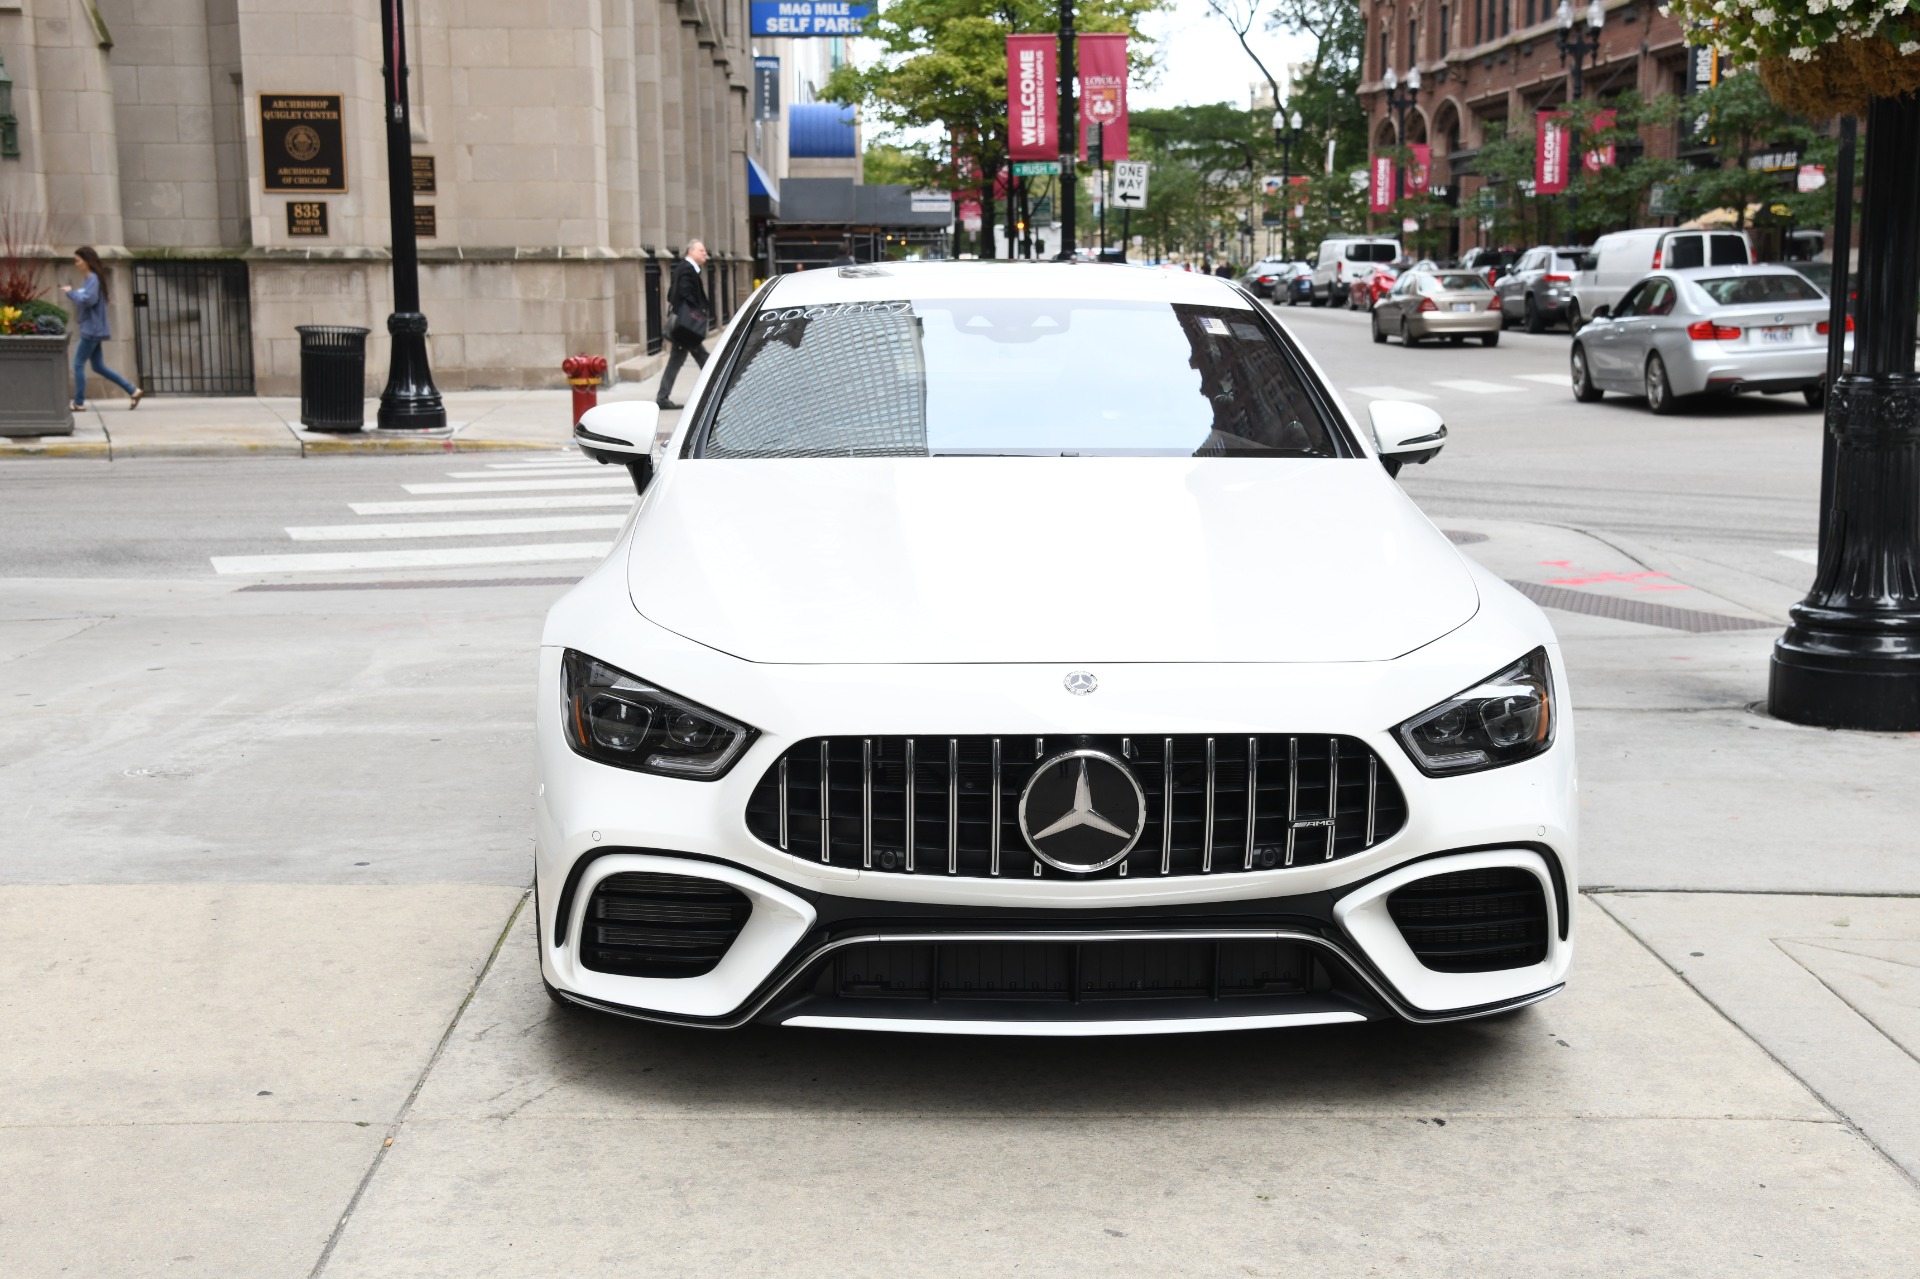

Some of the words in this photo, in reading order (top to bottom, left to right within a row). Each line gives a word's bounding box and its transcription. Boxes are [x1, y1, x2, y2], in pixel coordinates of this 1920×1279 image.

[779, 3, 812, 15] MAG
[814, 3, 849, 15] MILE
[766, 17, 810, 32] SELF
[813, 17, 863, 32] PARK
[755, 60, 779, 68] HOTEL
[1036, 50, 1044, 87] CAMPUS
[1085, 75, 1121, 85] LOYOLA
[1020, 50, 1037, 146] WELCOME
[1036, 88, 1045, 117] TOWER
[272, 100, 329, 109] ARCHBISHOP
[263, 111, 302, 120] QUIGLEY
[303, 111, 339, 119] CENTER
[278, 168, 331, 176] ARCHDIOCESE
[1022, 164, 1047, 175] RUSH
[1118, 165, 1144, 178] ONE
[282, 176, 292, 184] OF
[293, 176, 328, 184] CHICAGO
[1117, 178, 1144, 189] WAY
[294, 203, 320, 218] 835
